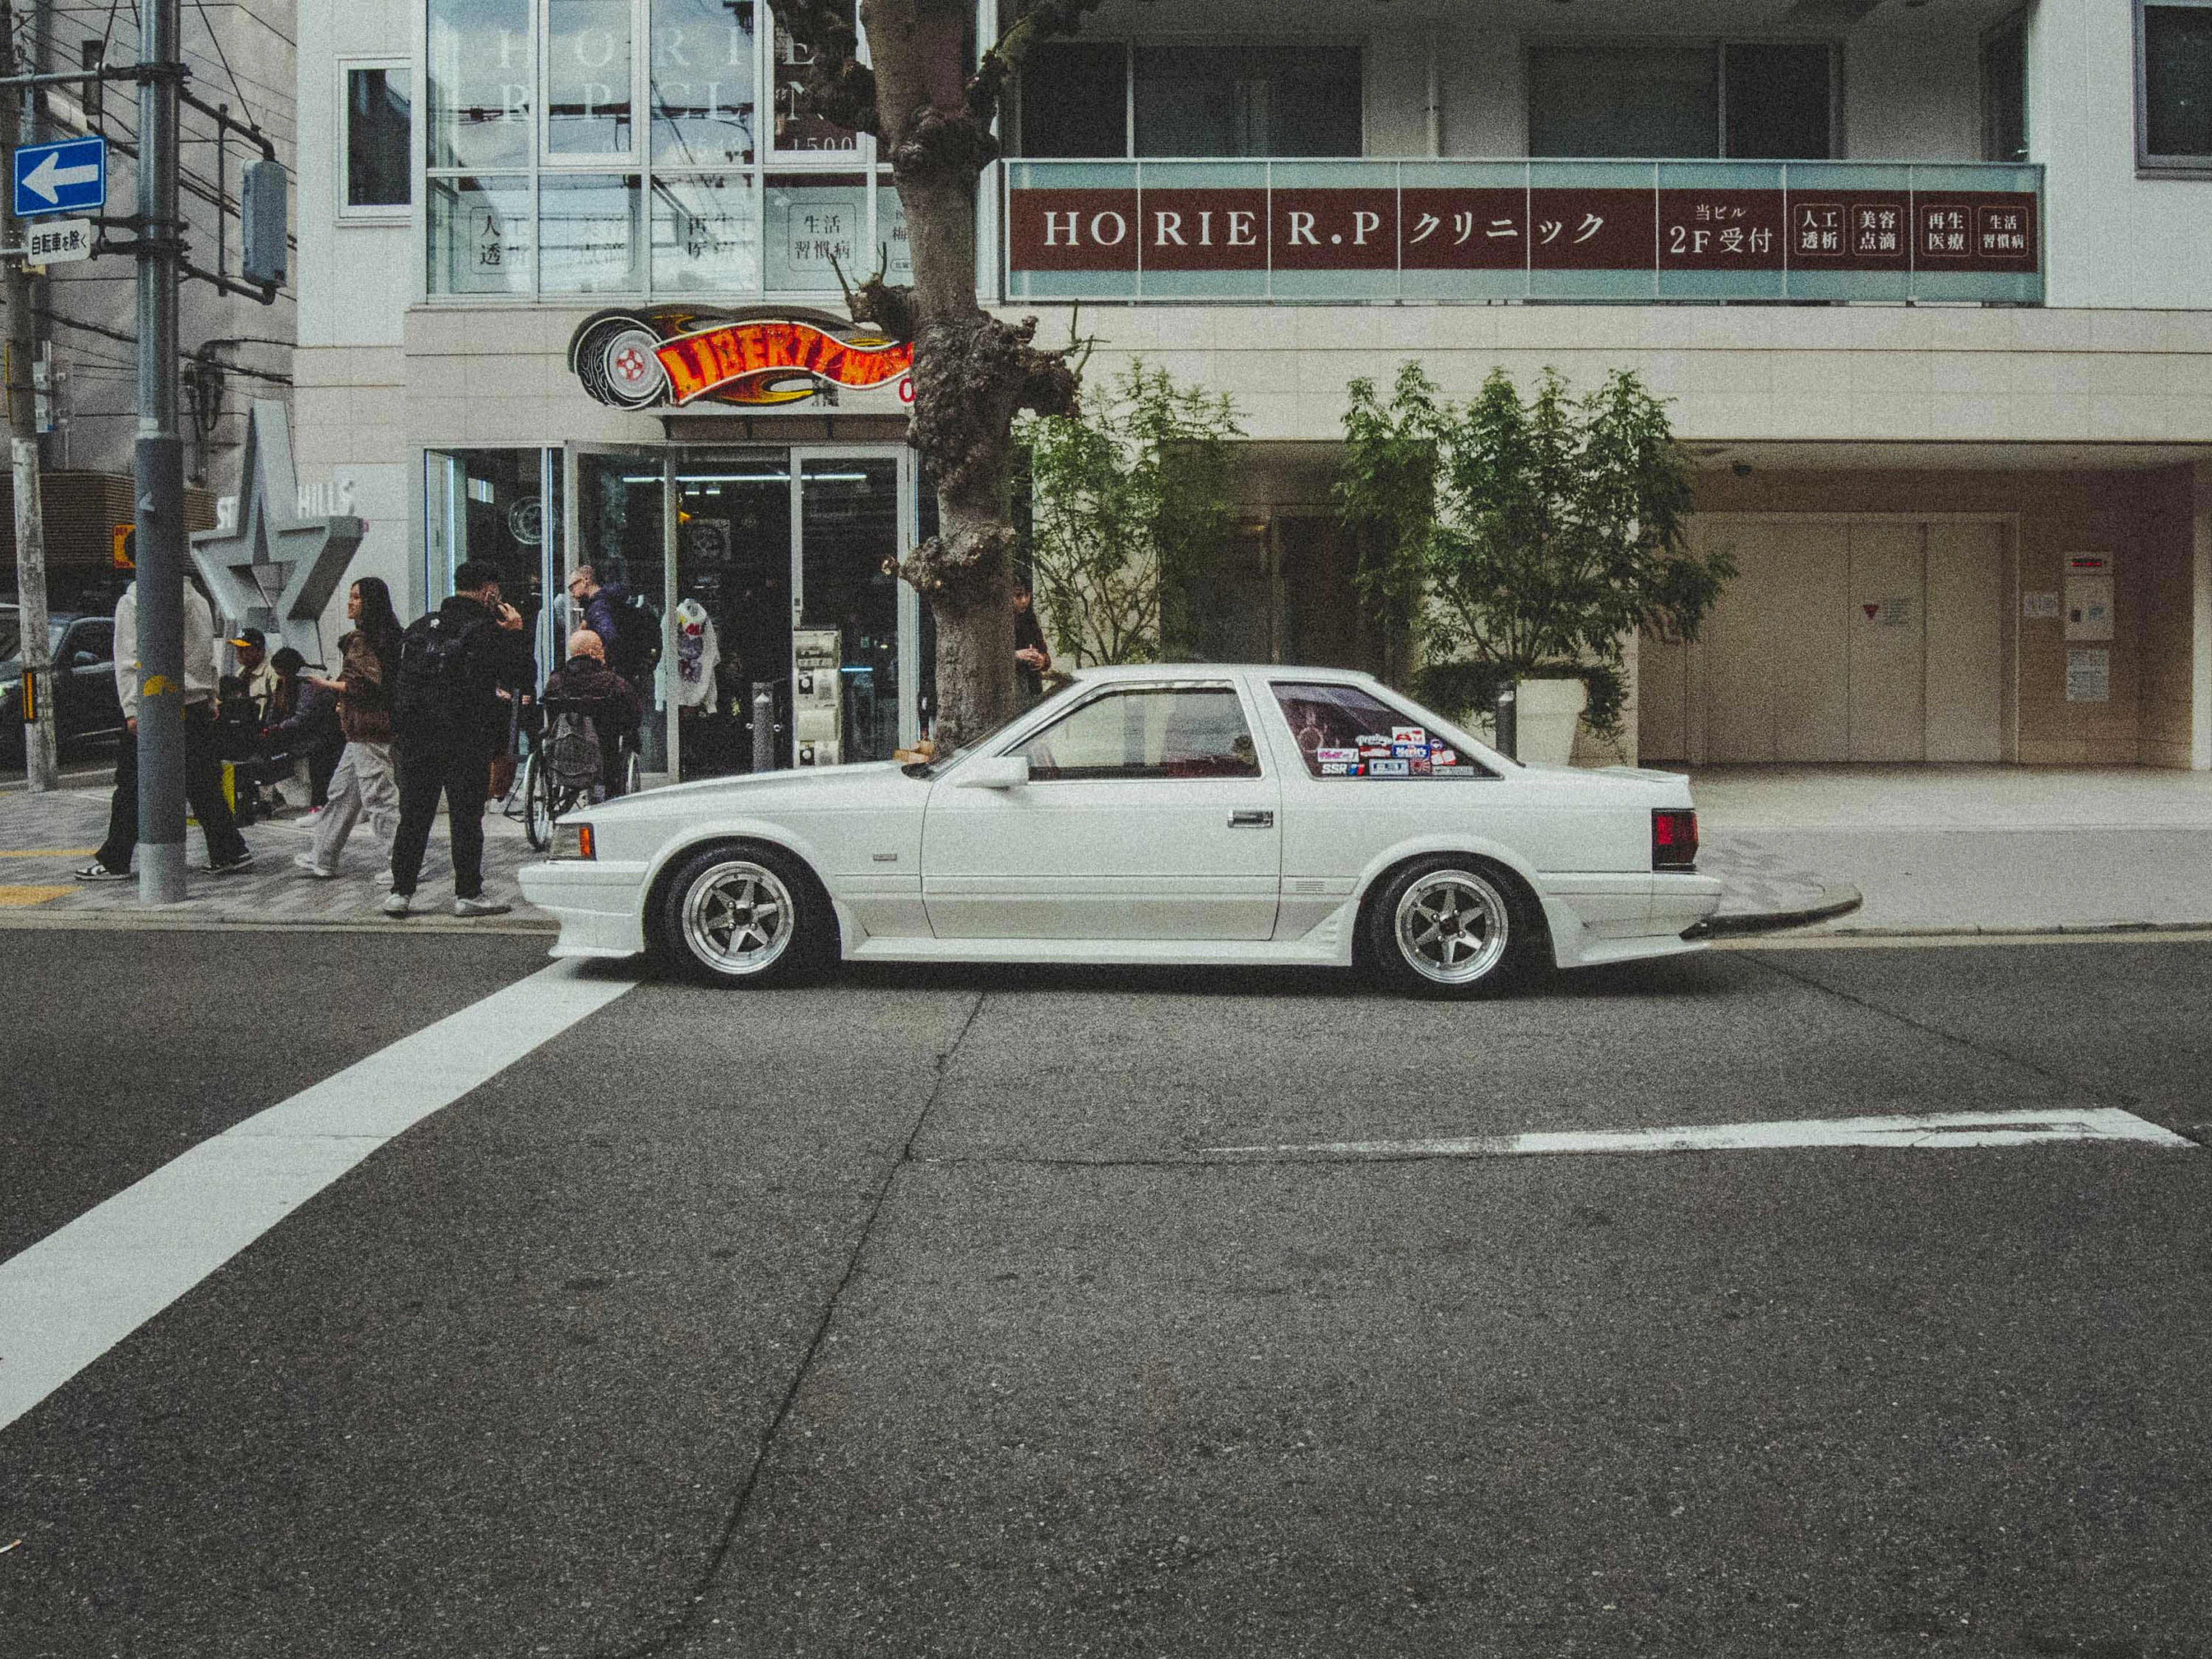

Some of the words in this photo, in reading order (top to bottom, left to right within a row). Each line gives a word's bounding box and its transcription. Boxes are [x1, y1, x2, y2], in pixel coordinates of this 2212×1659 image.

[1696, 204, 1746, 220] 当ビル
[1802, 210, 1838, 228] 人工
[1861, 210, 1895, 229] 美容
[1929, 211, 1963, 229] 再生
[804, 214, 840, 233] 生活
[1044, 211, 1256, 245] HORIE
[1288, 211, 1380, 245] R.P
[1410, 211, 1604, 245] クリニック
[1989, 214, 2017, 230] 生活
[32, 230, 86, 255] 自転車を除く
[1802, 231, 1838, 249] 透析
[1859, 232, 1896, 250] 点滴
[1929, 232, 1964, 250] 医療
[1983, 233, 2024, 249] 習慣病
[658, 323, 845, 400] LIBERTY
[298, 482, 355, 518] HILLS
[1321, 763, 1348, 774] SSR
